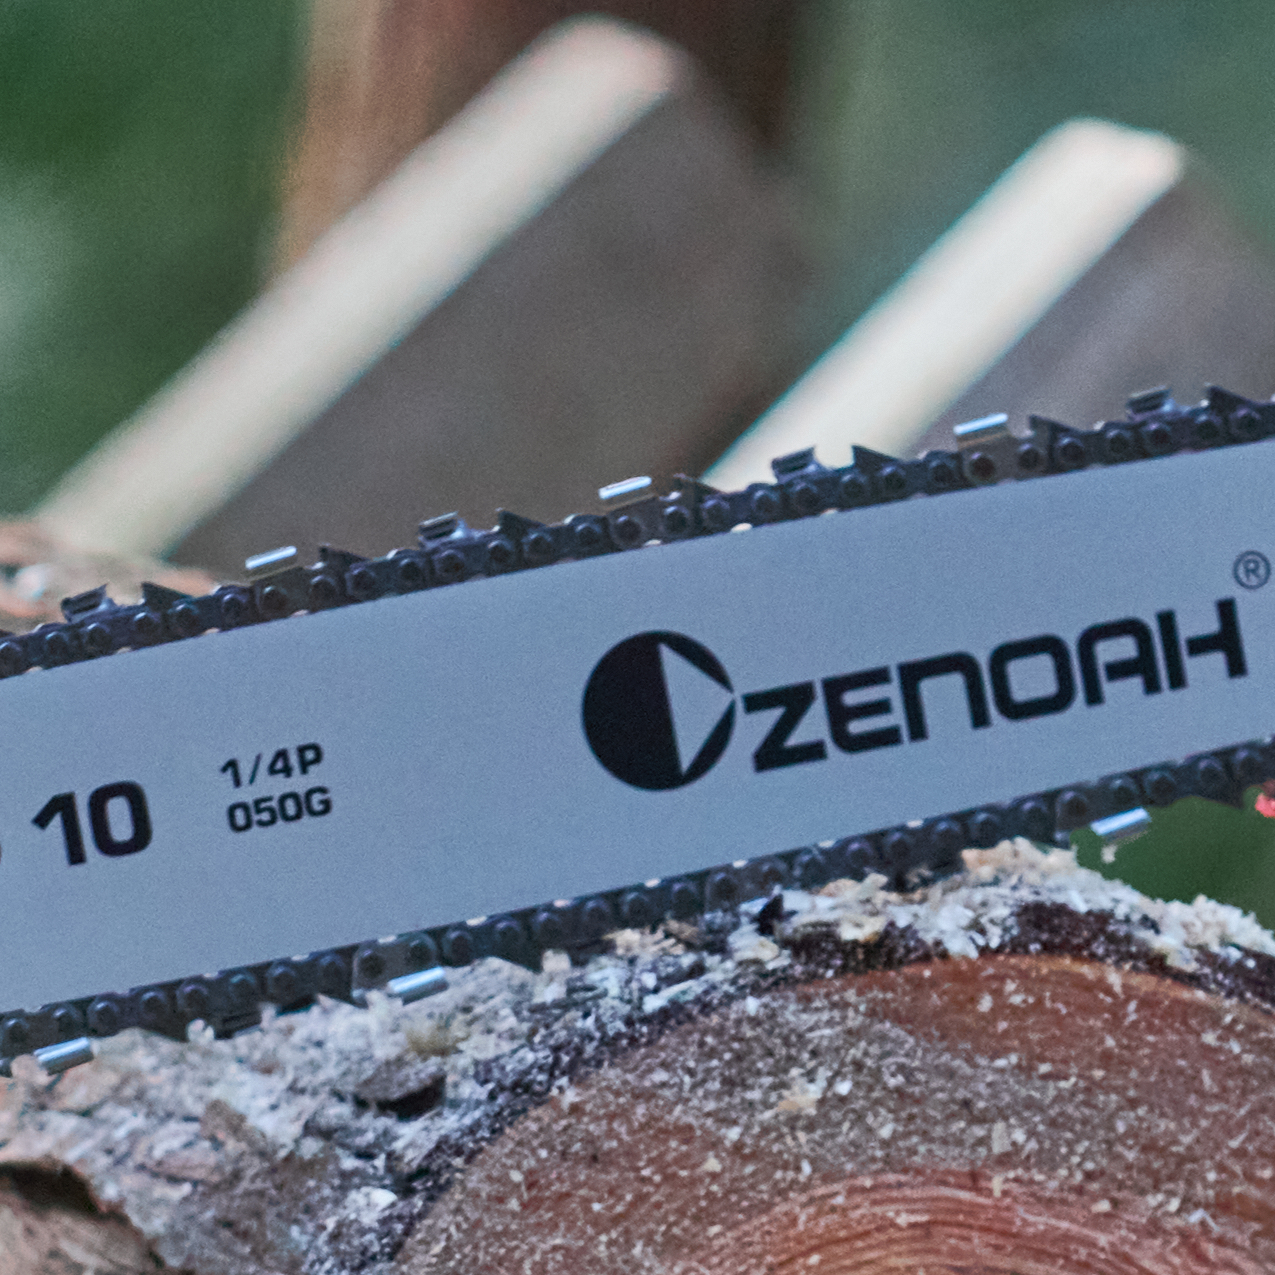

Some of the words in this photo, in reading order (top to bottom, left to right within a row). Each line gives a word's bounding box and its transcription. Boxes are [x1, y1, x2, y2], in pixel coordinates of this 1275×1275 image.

[742, 597, 1248, 774] ZENOAH
[219, 742, 324, 788] 1/4P
[30, 780, 153, 866] 10
[227, 786, 332, 833] 050G
